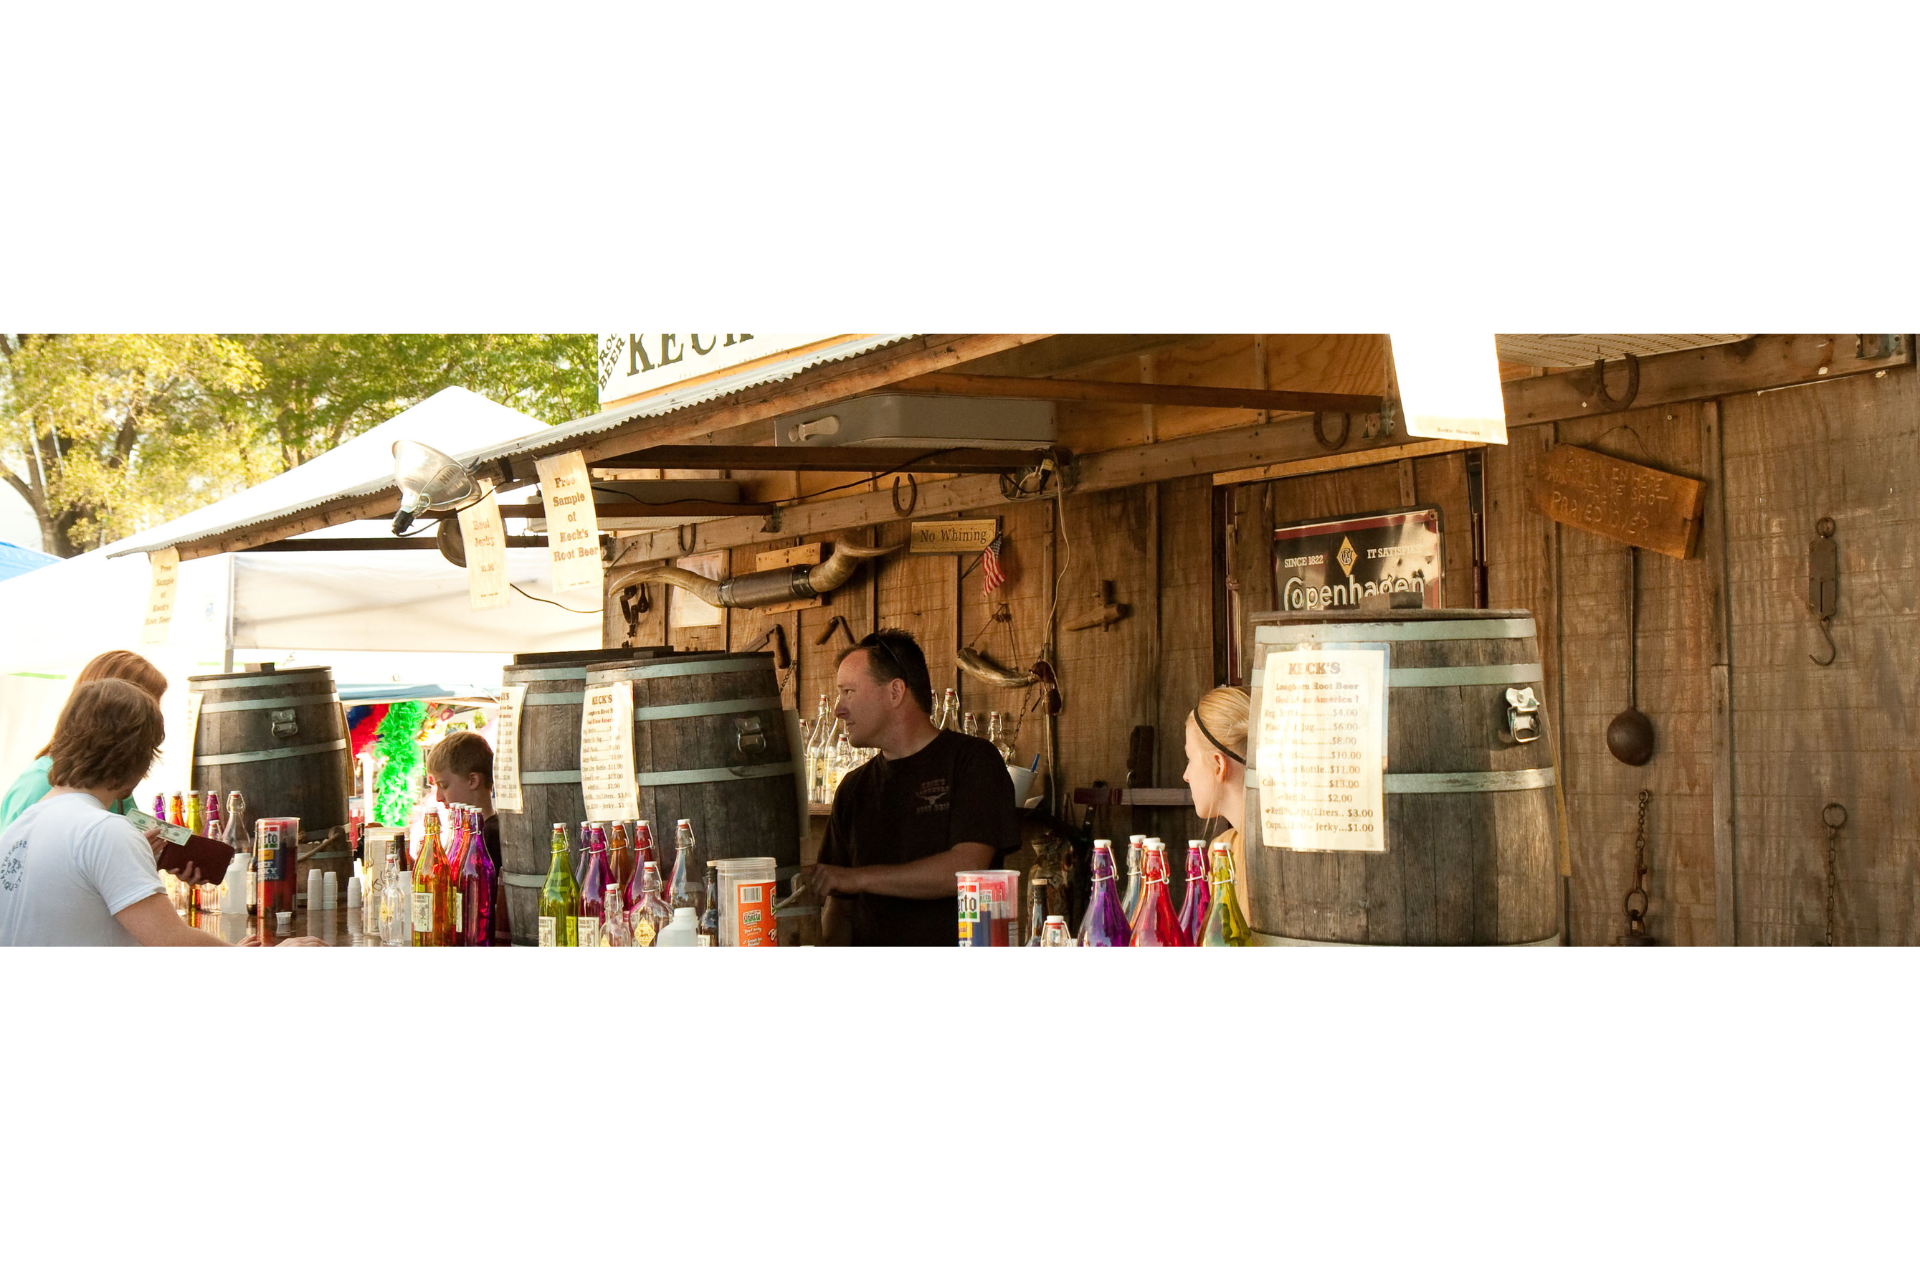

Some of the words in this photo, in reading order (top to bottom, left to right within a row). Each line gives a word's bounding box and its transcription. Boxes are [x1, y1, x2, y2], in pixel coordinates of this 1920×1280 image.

[627, 333, 754, 377] KE
[600, 337, 626, 391] BEER
[1611, 467, 1629, 482] IN
[554, 477, 576, 489] Free
[552, 492, 586, 507] Sample
[1631, 486, 1669, 513] SHOT
[567, 512, 577, 523] of
[559, 528, 589, 542] Keck's
[920, 529, 936, 543] No
[941, 527, 987, 545] Whining
[474, 535, 495, 548] Jerky
[553, 549, 576, 562] Root
[578, 546, 599, 558] Beer
[1367, 548, 1377, 559] IT
[1284, 556, 1307, 568] SINCE
[1308, 554, 1324, 566] 1822
[1284, 574, 1425, 611] Copenhagen
[1288, 662, 1341, 675] KECK'S
[1275, 683, 1310, 692] Longhrn
[1312, 682, 1333, 690] Root
[1335, 682, 1359, 690] Beer
[1314, 695, 1352, 704] America
[1333, 708, 1358, 717] $4.00
[1333, 722, 1358, 731] $6.00
[1332, 737, 1357, 745] $8.00
[1331, 751, 1362, 760] $10.00
[1300, 765, 1325, 774] Bottle
[1329, 765, 1361, 774] $11.00
[1329, 780, 1360, 789] $13.00
[1328, 794, 1353, 803] $2.00
[1347, 809, 1374, 818] $3.00
[1315, 822, 1339, 833] Jerky
[1347, 823, 1374, 832] $1.00
